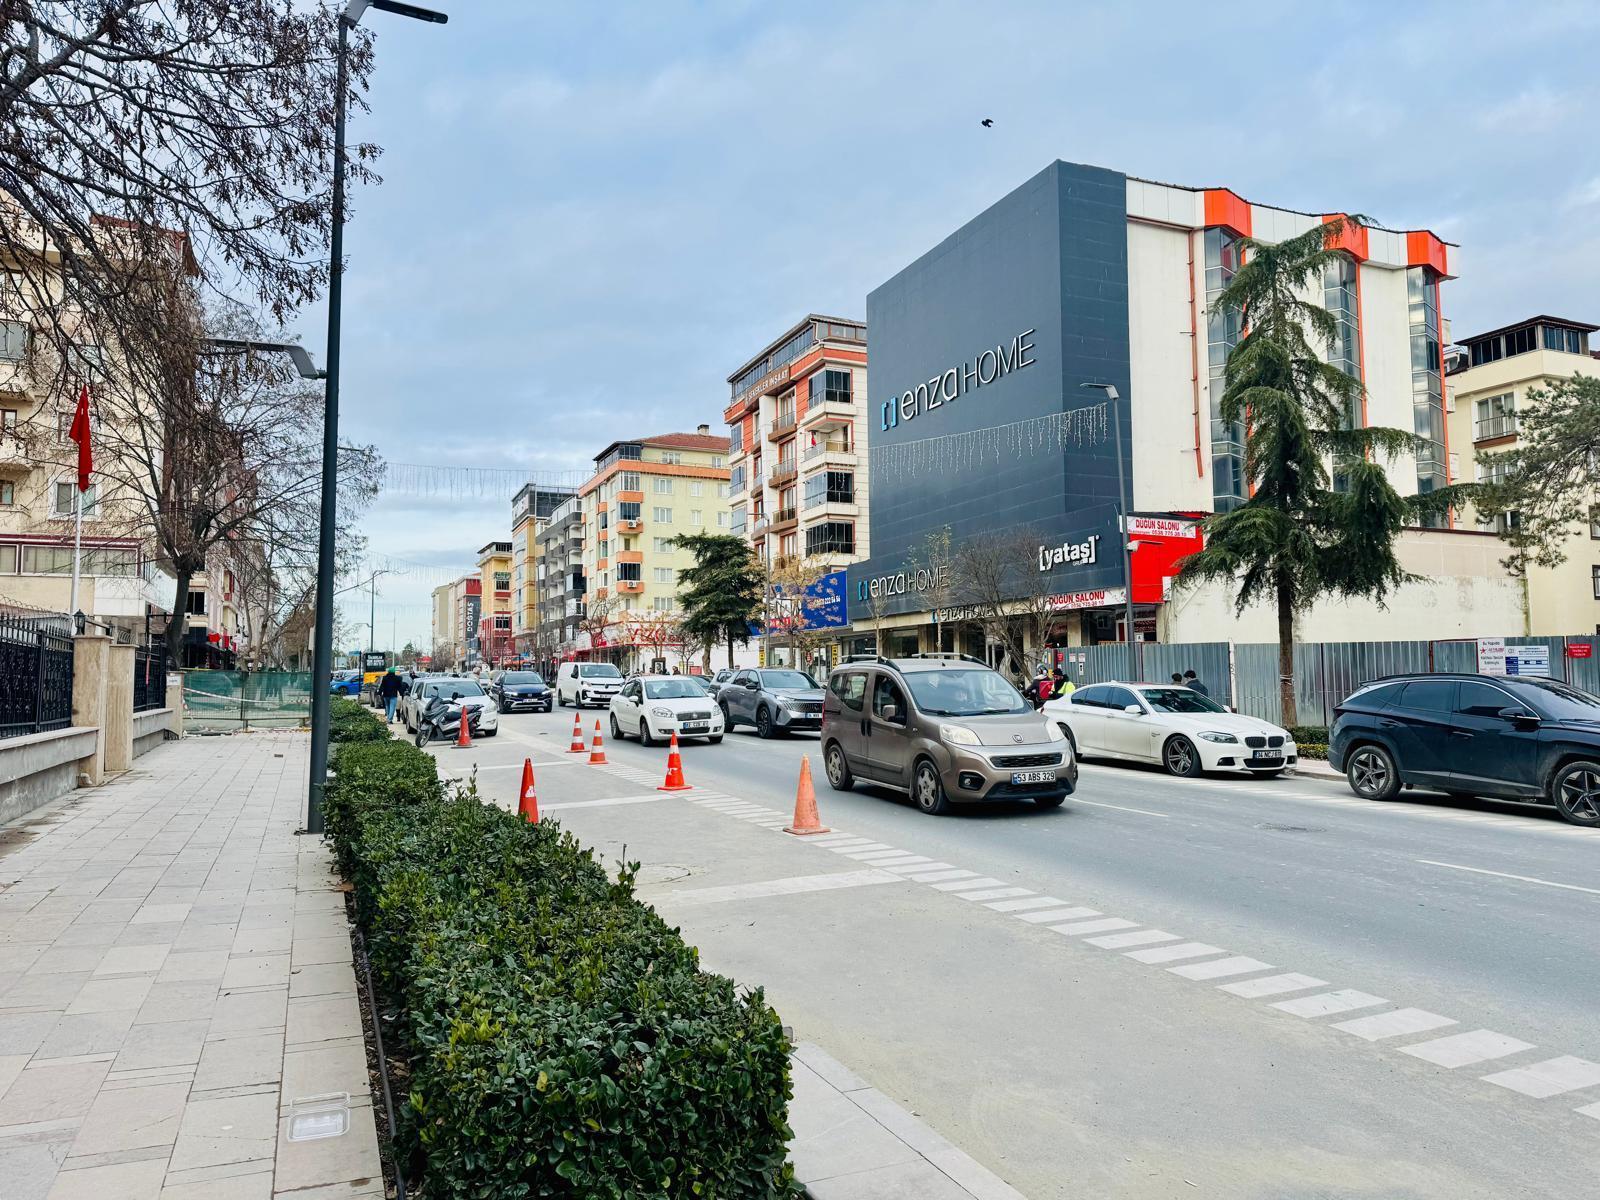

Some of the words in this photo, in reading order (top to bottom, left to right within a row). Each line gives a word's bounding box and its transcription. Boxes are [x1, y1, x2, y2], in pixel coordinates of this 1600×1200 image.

[901, 367, 958, 420] enza
[963, 328, 1035, 393] HOME
[1157, 520, 1180, 531] SALONU
[870, 571, 905, 598] enza
[907, 565, 949, 592] HOME
[1075, 590, 1105, 603] SALONU
[1028, 772, 1041, 781] ABS
[1042, 771, 1055, 780] 329
